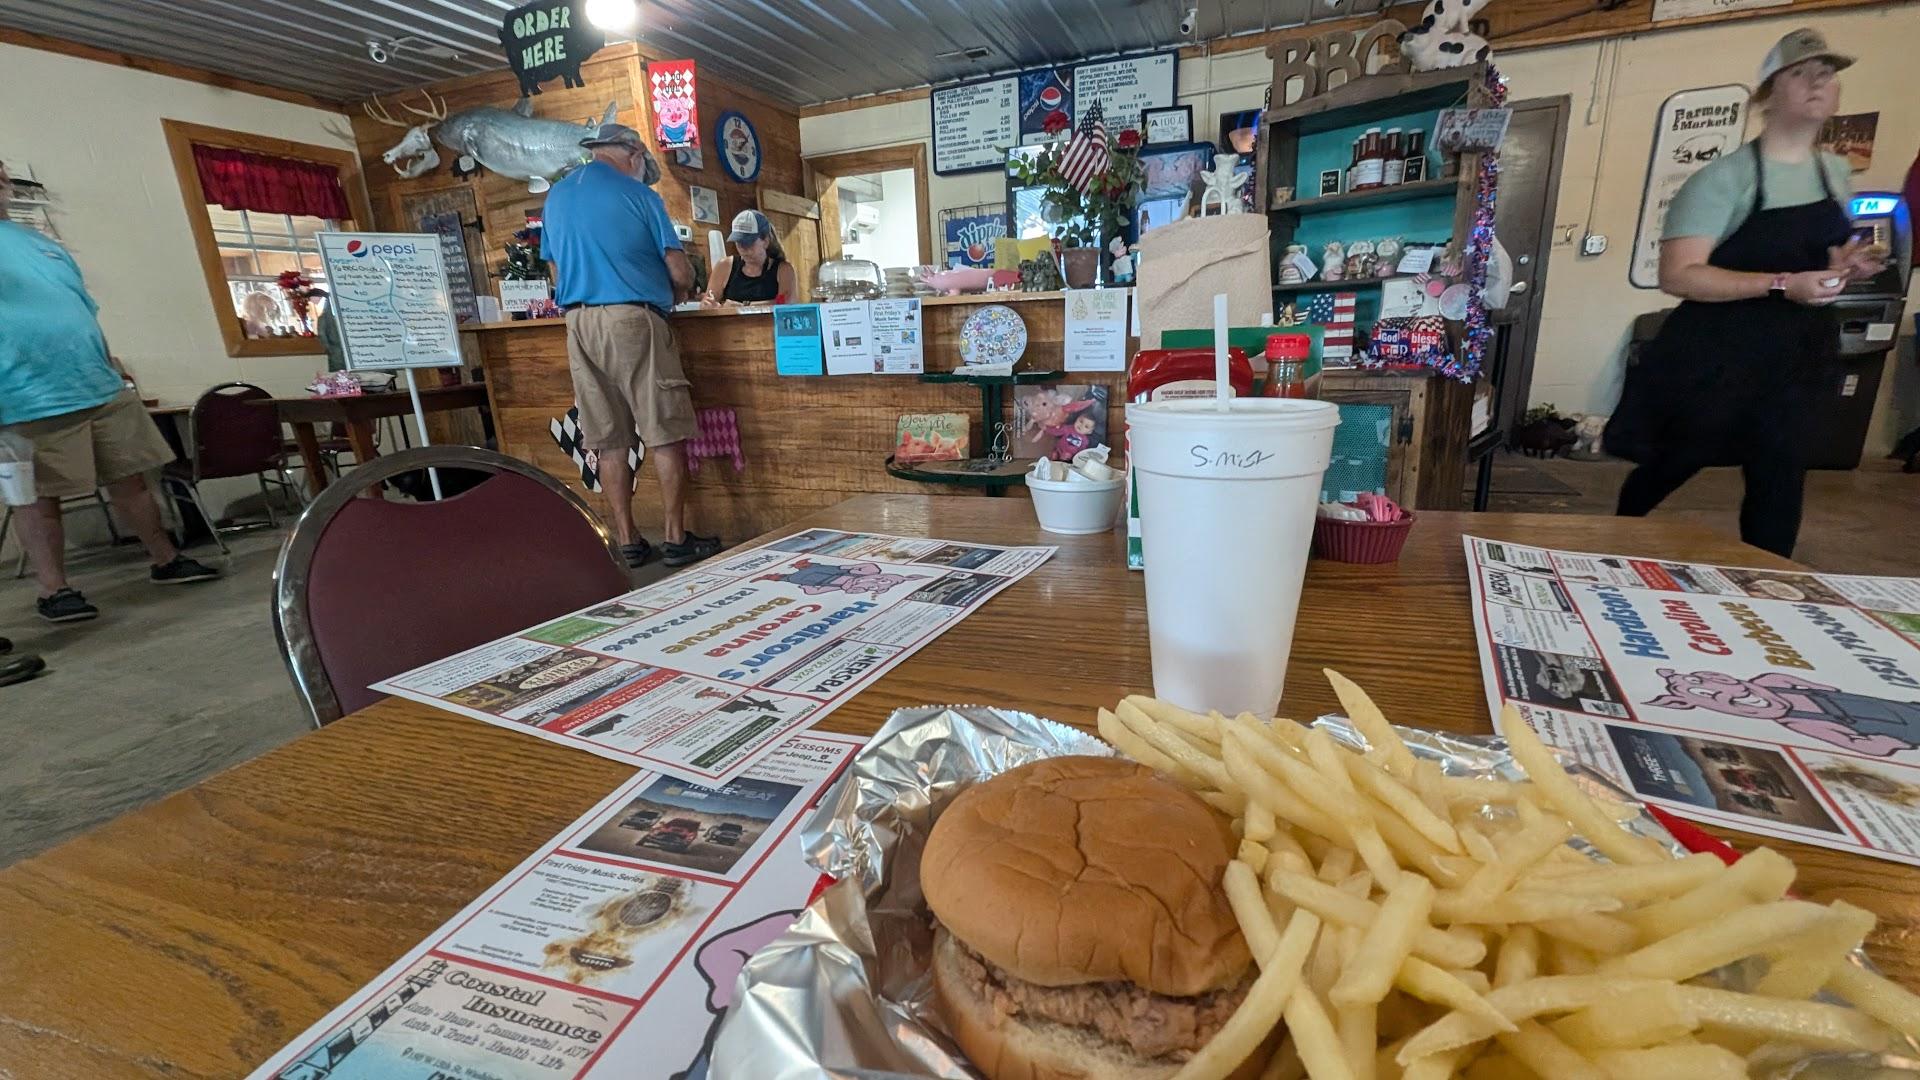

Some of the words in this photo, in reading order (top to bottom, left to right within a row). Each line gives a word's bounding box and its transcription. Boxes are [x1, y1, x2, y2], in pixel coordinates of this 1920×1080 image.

[512, 6, 571, 40] ORDER
[522, 35, 567, 71] HERE
[1853, 200, 1879, 213] TM
[372, 243, 416, 256] pepsi
[1382, 332, 1397, 342] God
[1412, 333, 1437, 344] bless
[901, 414, 927, 428] You
[929, 415, 953, 430] Me
[603, 610, 710, 651] 792-2666
[662, 598, 794, 654] Barbecue
[705, 604, 821, 657] Carolina
[1588, 584, 1668, 659] Hardison's
[1662, 600, 1732, 655] Carolina
[1721, 602, 1814, 670] Barbecue
[719, 602, 875, 680] Hardison's
[808, 655, 880, 693] NERSBA
[778, 703, 819, 728] Albemarle
[744, 728, 782, 751] Chimney
[779, 738, 842, 755] SESSOMS
[786, 752, 812, 761] Jeep
[714, 752, 746, 772] Sweep
[540, 858, 566, 868] First
[563, 863, 590, 874] Friday
[588, 868, 619, 878] Music
[615, 872, 647, 883] Series
[445, 971, 546, 1006] Coastal
[401, 1000, 438, 1017] Auto
[438, 1010, 480, 1028] Home
[481, 1023, 560, 1050] Commercial
[564, 1046, 594, 1060] ATV
[463, 996, 601, 1043] Insurance
[399, 1016, 435, 1032] Auto
[440, 1029, 482, 1046] Truck
[483, 1040, 533, 1061] Health
[537, 1055, 564, 1070] Life
